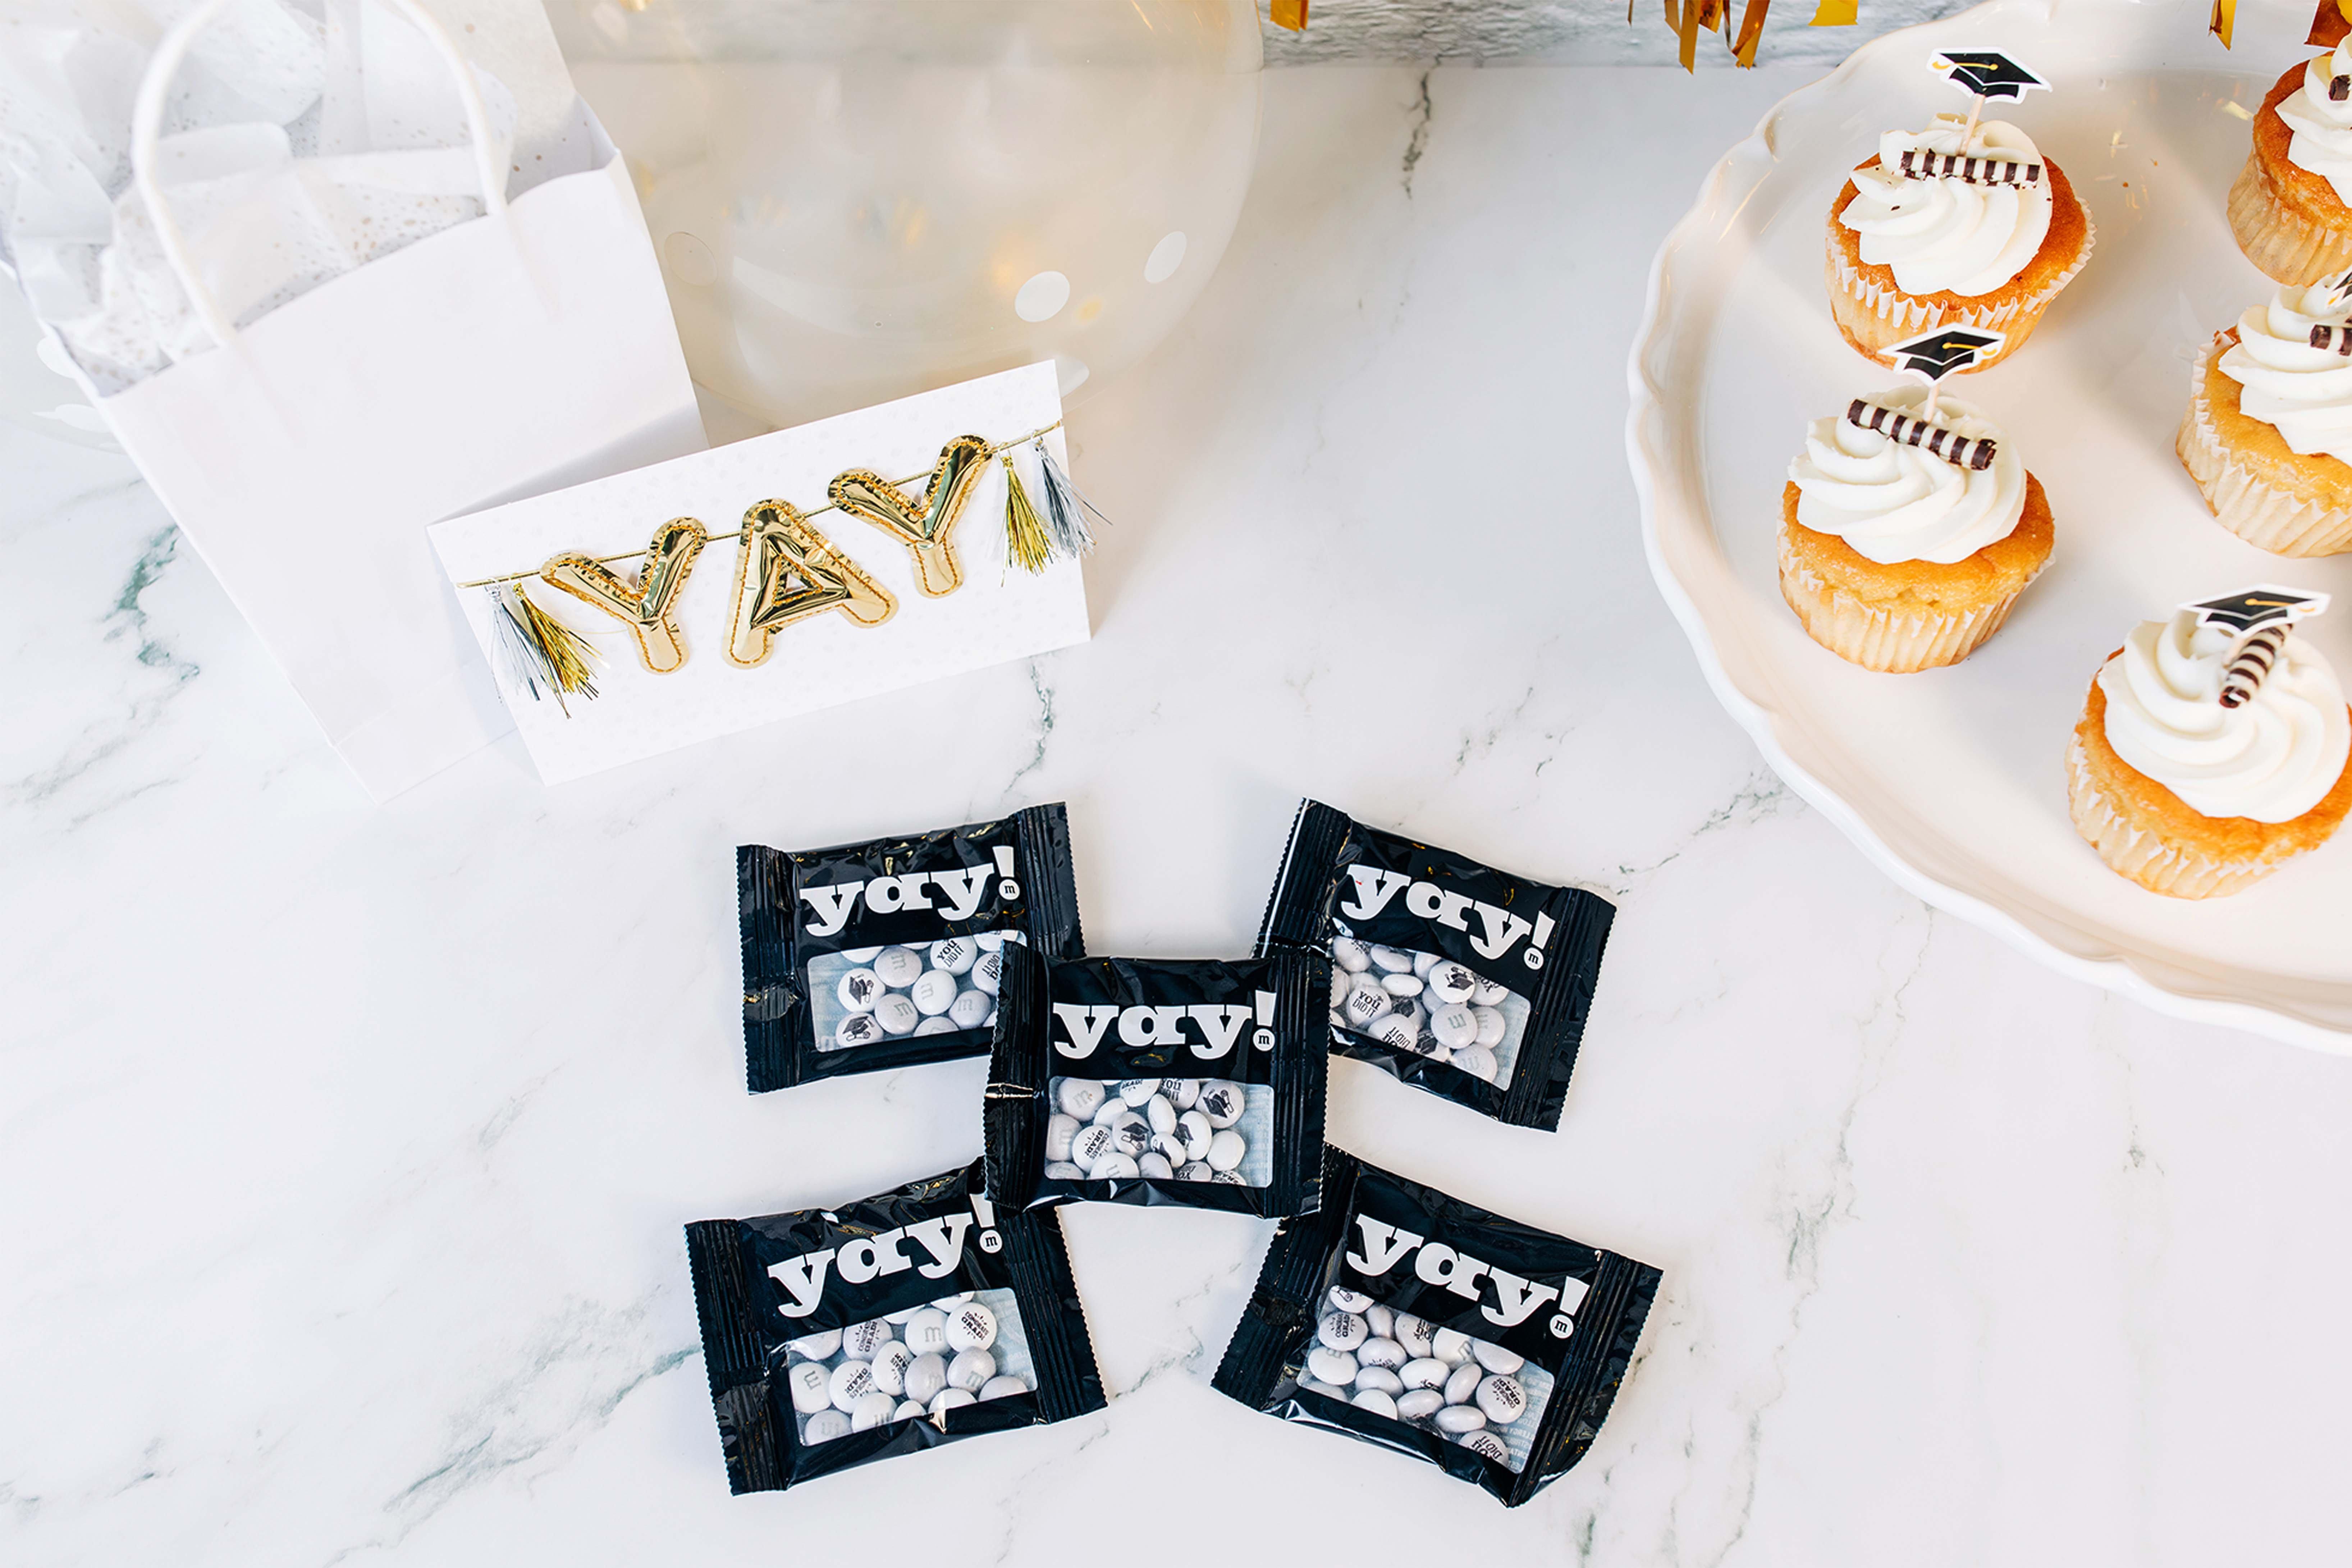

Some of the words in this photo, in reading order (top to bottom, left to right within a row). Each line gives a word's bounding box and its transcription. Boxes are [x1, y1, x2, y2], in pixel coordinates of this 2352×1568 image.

[540, 434, 992, 674] YAY
[799, 846, 1020, 936] yay!
[1005, 885, 1015, 894] m
[1341, 864, 1555, 970] yay!
[1528, 953, 1539, 964] m
[1358, 991, 1380, 1010] YOU
[1053, 990, 1277, 1059] yay!
[1258, 1035, 1269, 1045] m
[767, 1193, 1002, 1317] yay!
[985, 1236, 998, 1247] m
[1346, 1213, 1590, 1338] yay!
[1555, 1320, 1568, 1332] m
